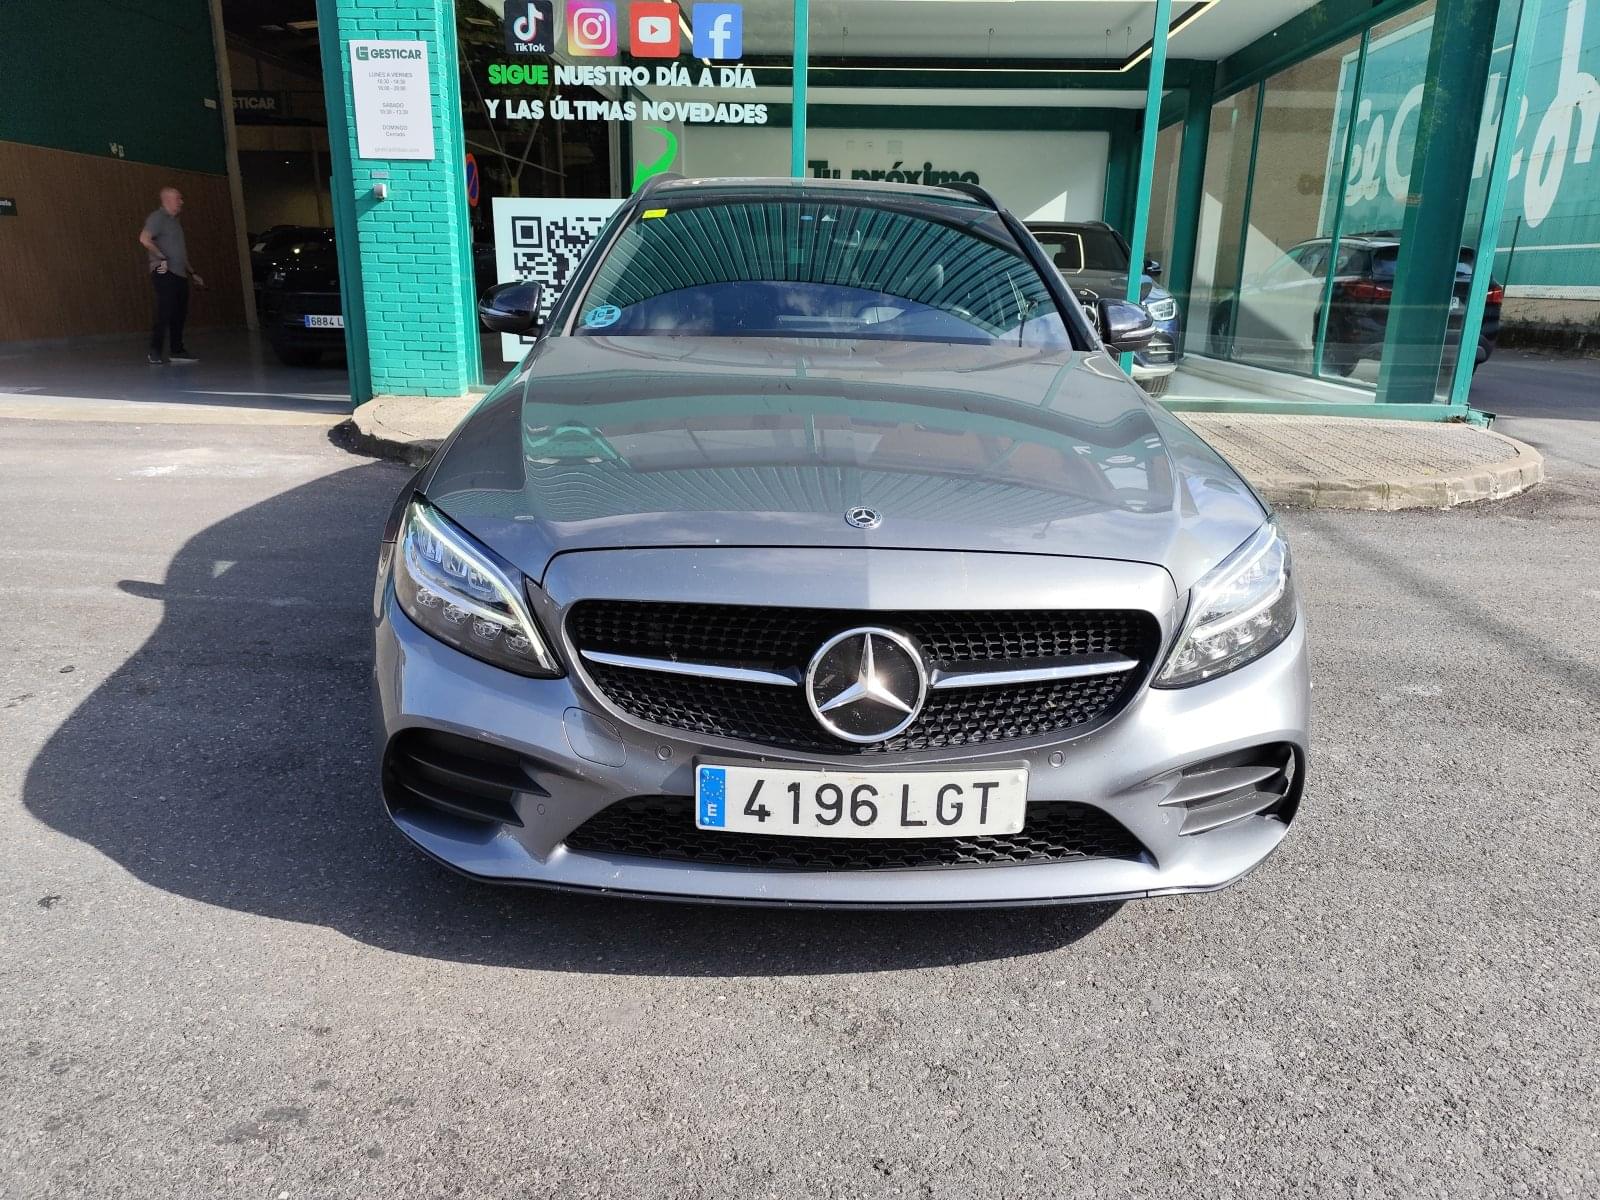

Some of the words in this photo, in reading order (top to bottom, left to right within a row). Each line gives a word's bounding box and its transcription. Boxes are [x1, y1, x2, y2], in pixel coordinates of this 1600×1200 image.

[371, 49, 421, 59] GESTICAR
[514, 43, 545, 52] TikTok
[488, 64, 549, 85] SIGUE
[554, 65, 650, 86] NUESTRO
[656, 62, 692, 87] DÍA
[698, 67, 714, 88] A
[720, 64, 756, 88] DÍA
[485, 99, 500, 119] Y
[505, 99, 544, 119] LAS
[550, 95, 637, 121] ÚLTIMAS
[643, 101, 768, 124] NOVEDADES
[311, 316, 334, 326] 6884
[707, 803, 718, 817] E
[743, 779, 878, 827] 4196
[900, 781, 999, 827] LGT
